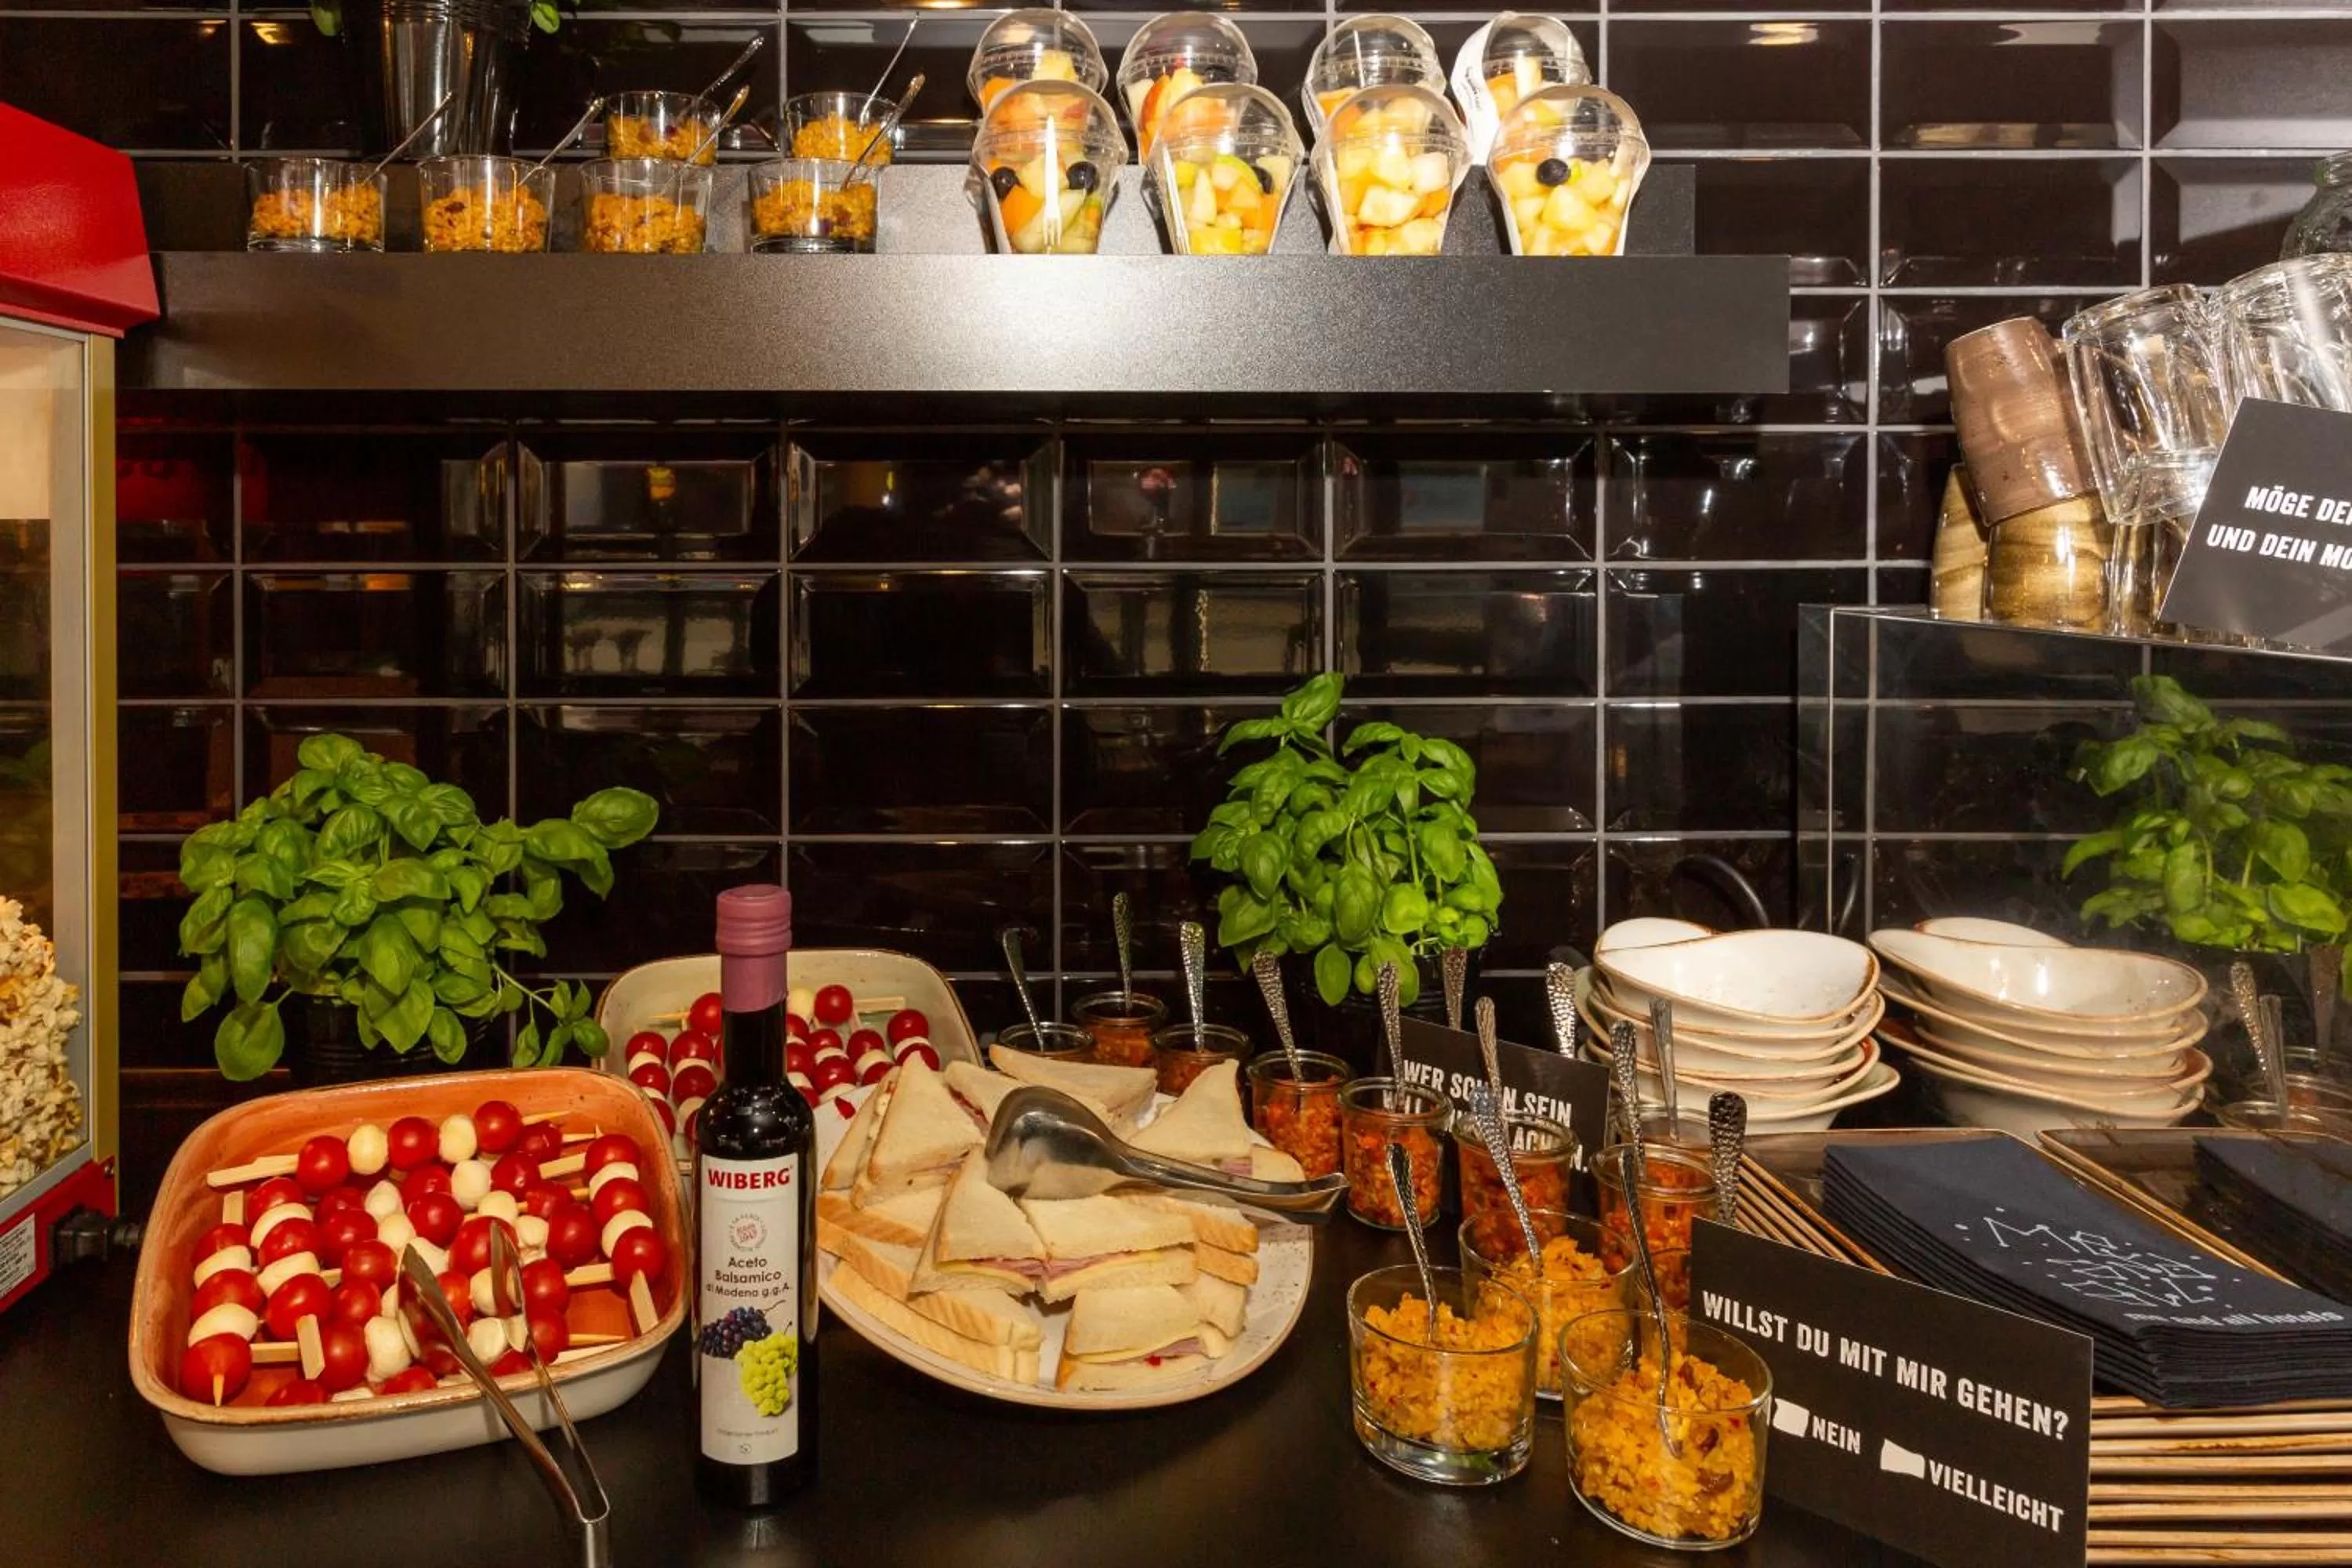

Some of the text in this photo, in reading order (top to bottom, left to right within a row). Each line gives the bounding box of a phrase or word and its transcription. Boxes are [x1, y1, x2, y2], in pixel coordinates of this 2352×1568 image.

[2245, 485, 2314, 518] MÖGE
[2207, 524, 2256, 552] UND
[2259, 533, 2317, 563] DEIN
[1403, 1059, 1573, 1130] WER SCN SEIN
[708, 1167, 791, 1190] WIBERG
[715, 1269, 782, 1283] Balsamico
[728, 1257, 768, 1269] Aceto
[714, 1285, 759, 1298] Modena
[1702, 1290, 2070, 1441] WILLST DU MIT MIR GEHEN?
[1812, 1414, 2064, 1533] NEIN VIELLEICHT
